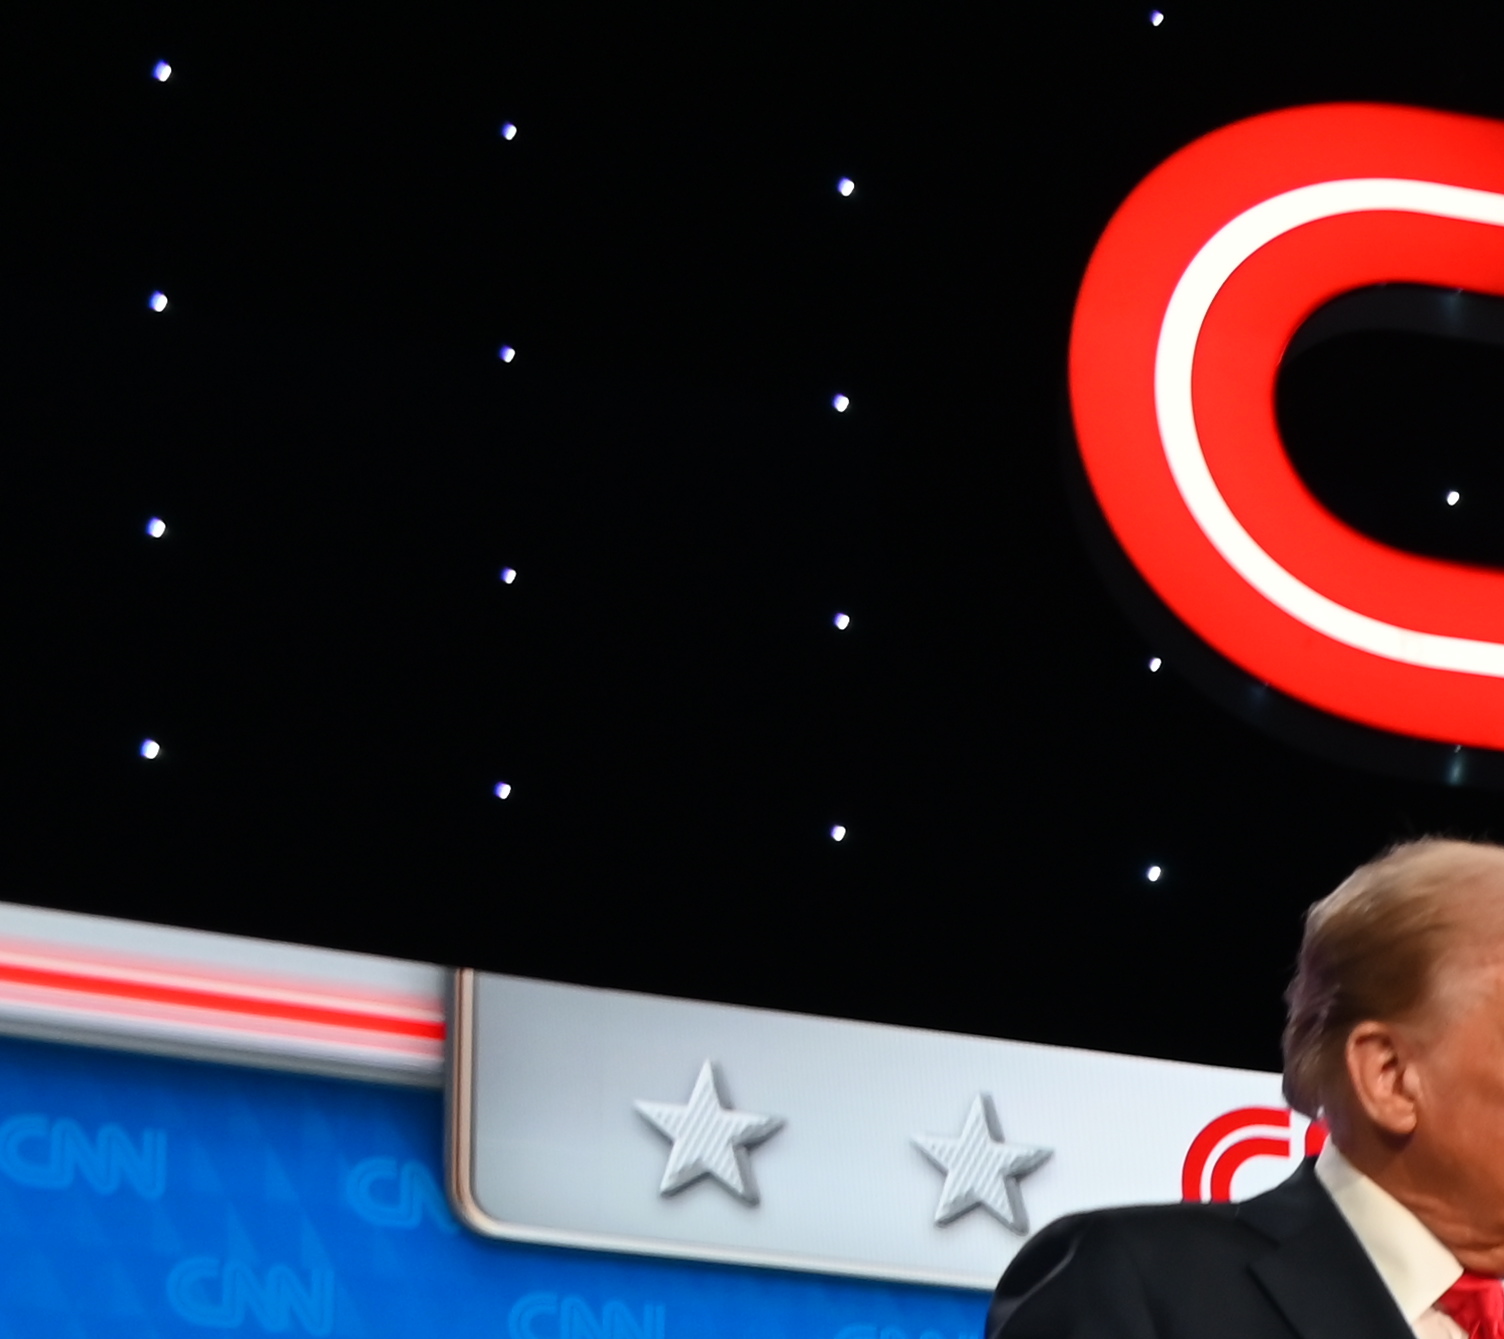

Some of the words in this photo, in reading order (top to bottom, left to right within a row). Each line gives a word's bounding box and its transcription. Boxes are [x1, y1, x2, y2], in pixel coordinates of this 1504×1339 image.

[0, 1113, 167, 1199] CNN
[345, 1156, 460, 1233] CN
[167, 1255, 335, 1336] CNN
